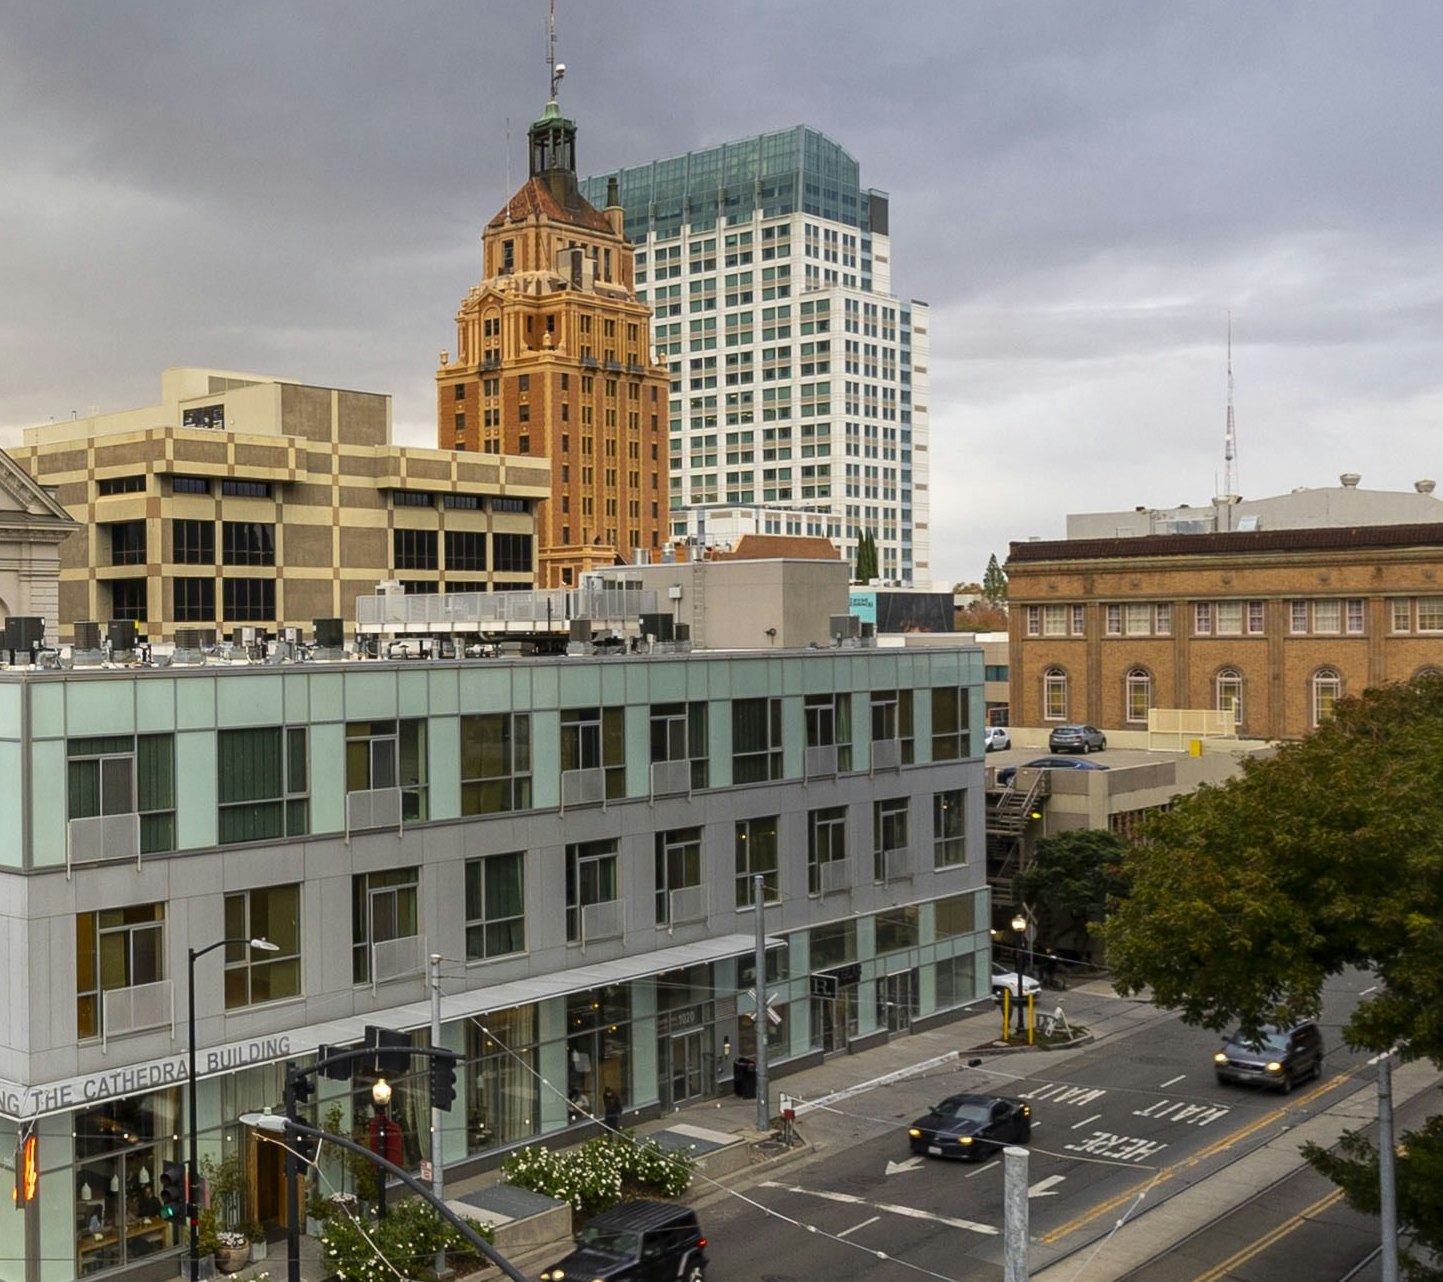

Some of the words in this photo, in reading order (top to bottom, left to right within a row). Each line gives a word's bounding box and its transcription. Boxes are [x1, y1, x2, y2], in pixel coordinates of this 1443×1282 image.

[31, 1084, 73, 1112] THE
[208, 1036, 291, 1071] BUILDING
[1017, 1083, 1107, 1106] WAIT
[1132, 1099, 1230, 1126] WAIT
